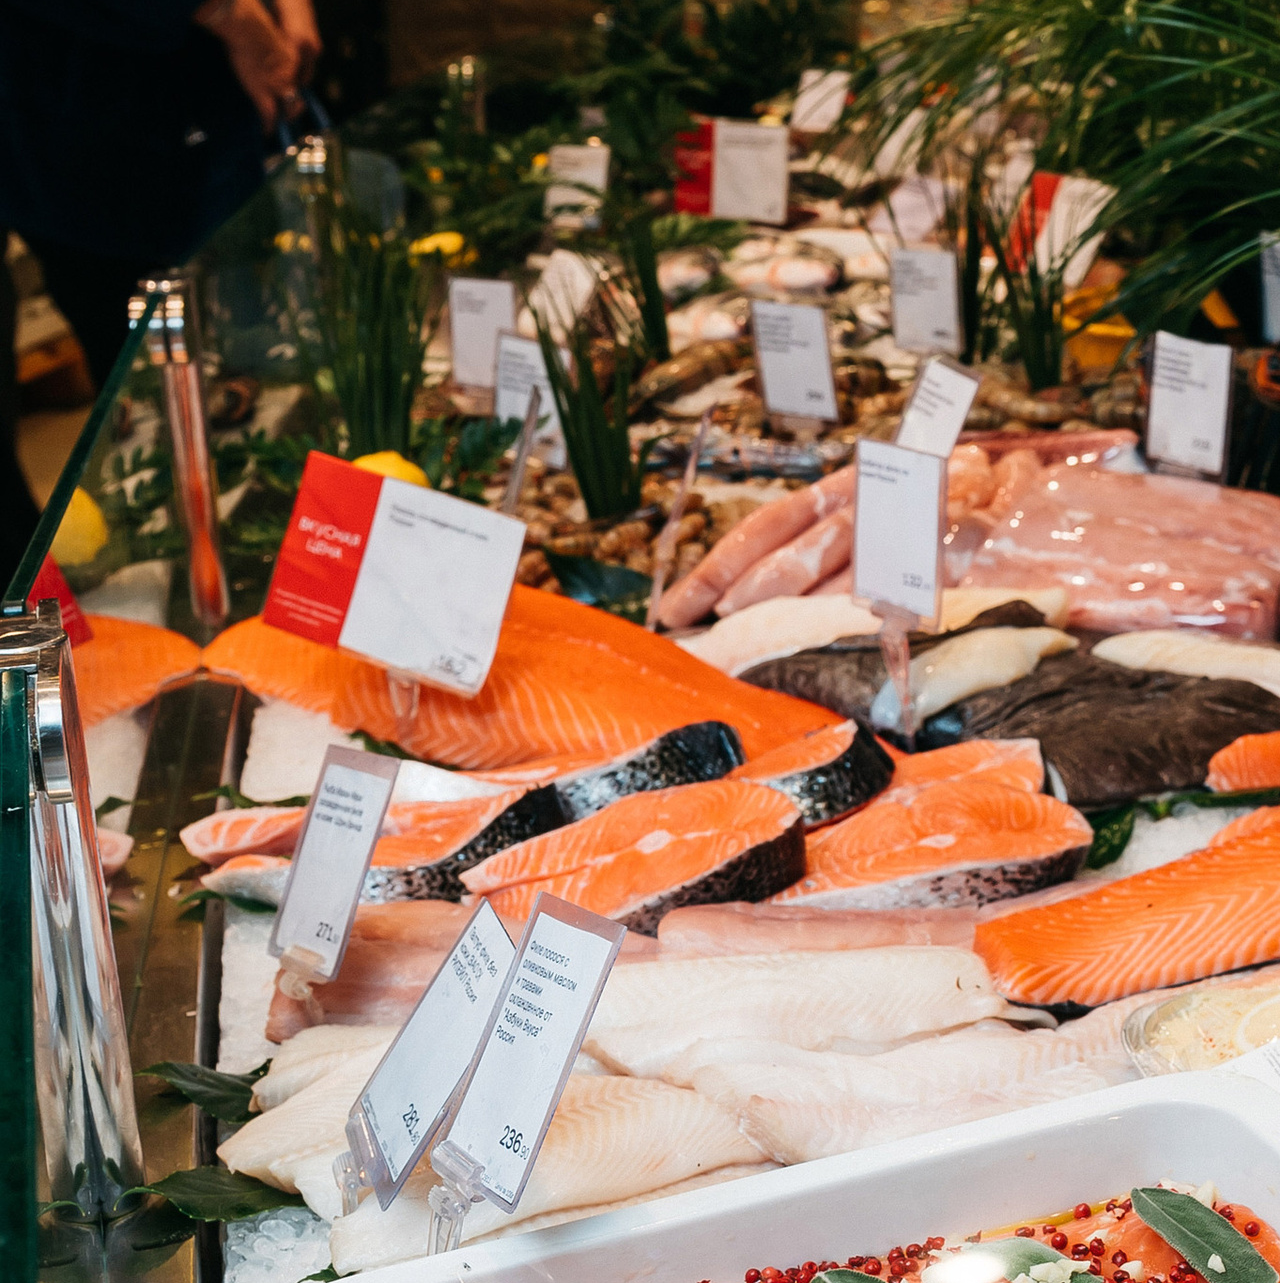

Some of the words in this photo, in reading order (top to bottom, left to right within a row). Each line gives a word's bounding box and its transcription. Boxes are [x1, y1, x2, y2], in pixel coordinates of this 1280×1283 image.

[530, 940, 543, 956] Филе
[543, 946, 565, 965] лосося
[522, 977, 544, 998] травами
[523, 959, 553, 980] оливковым
[553, 973, 578, 993] маслом
[509, 993, 543, 1019] охлажденное
[495, 1024, 516, 1046] Россия
